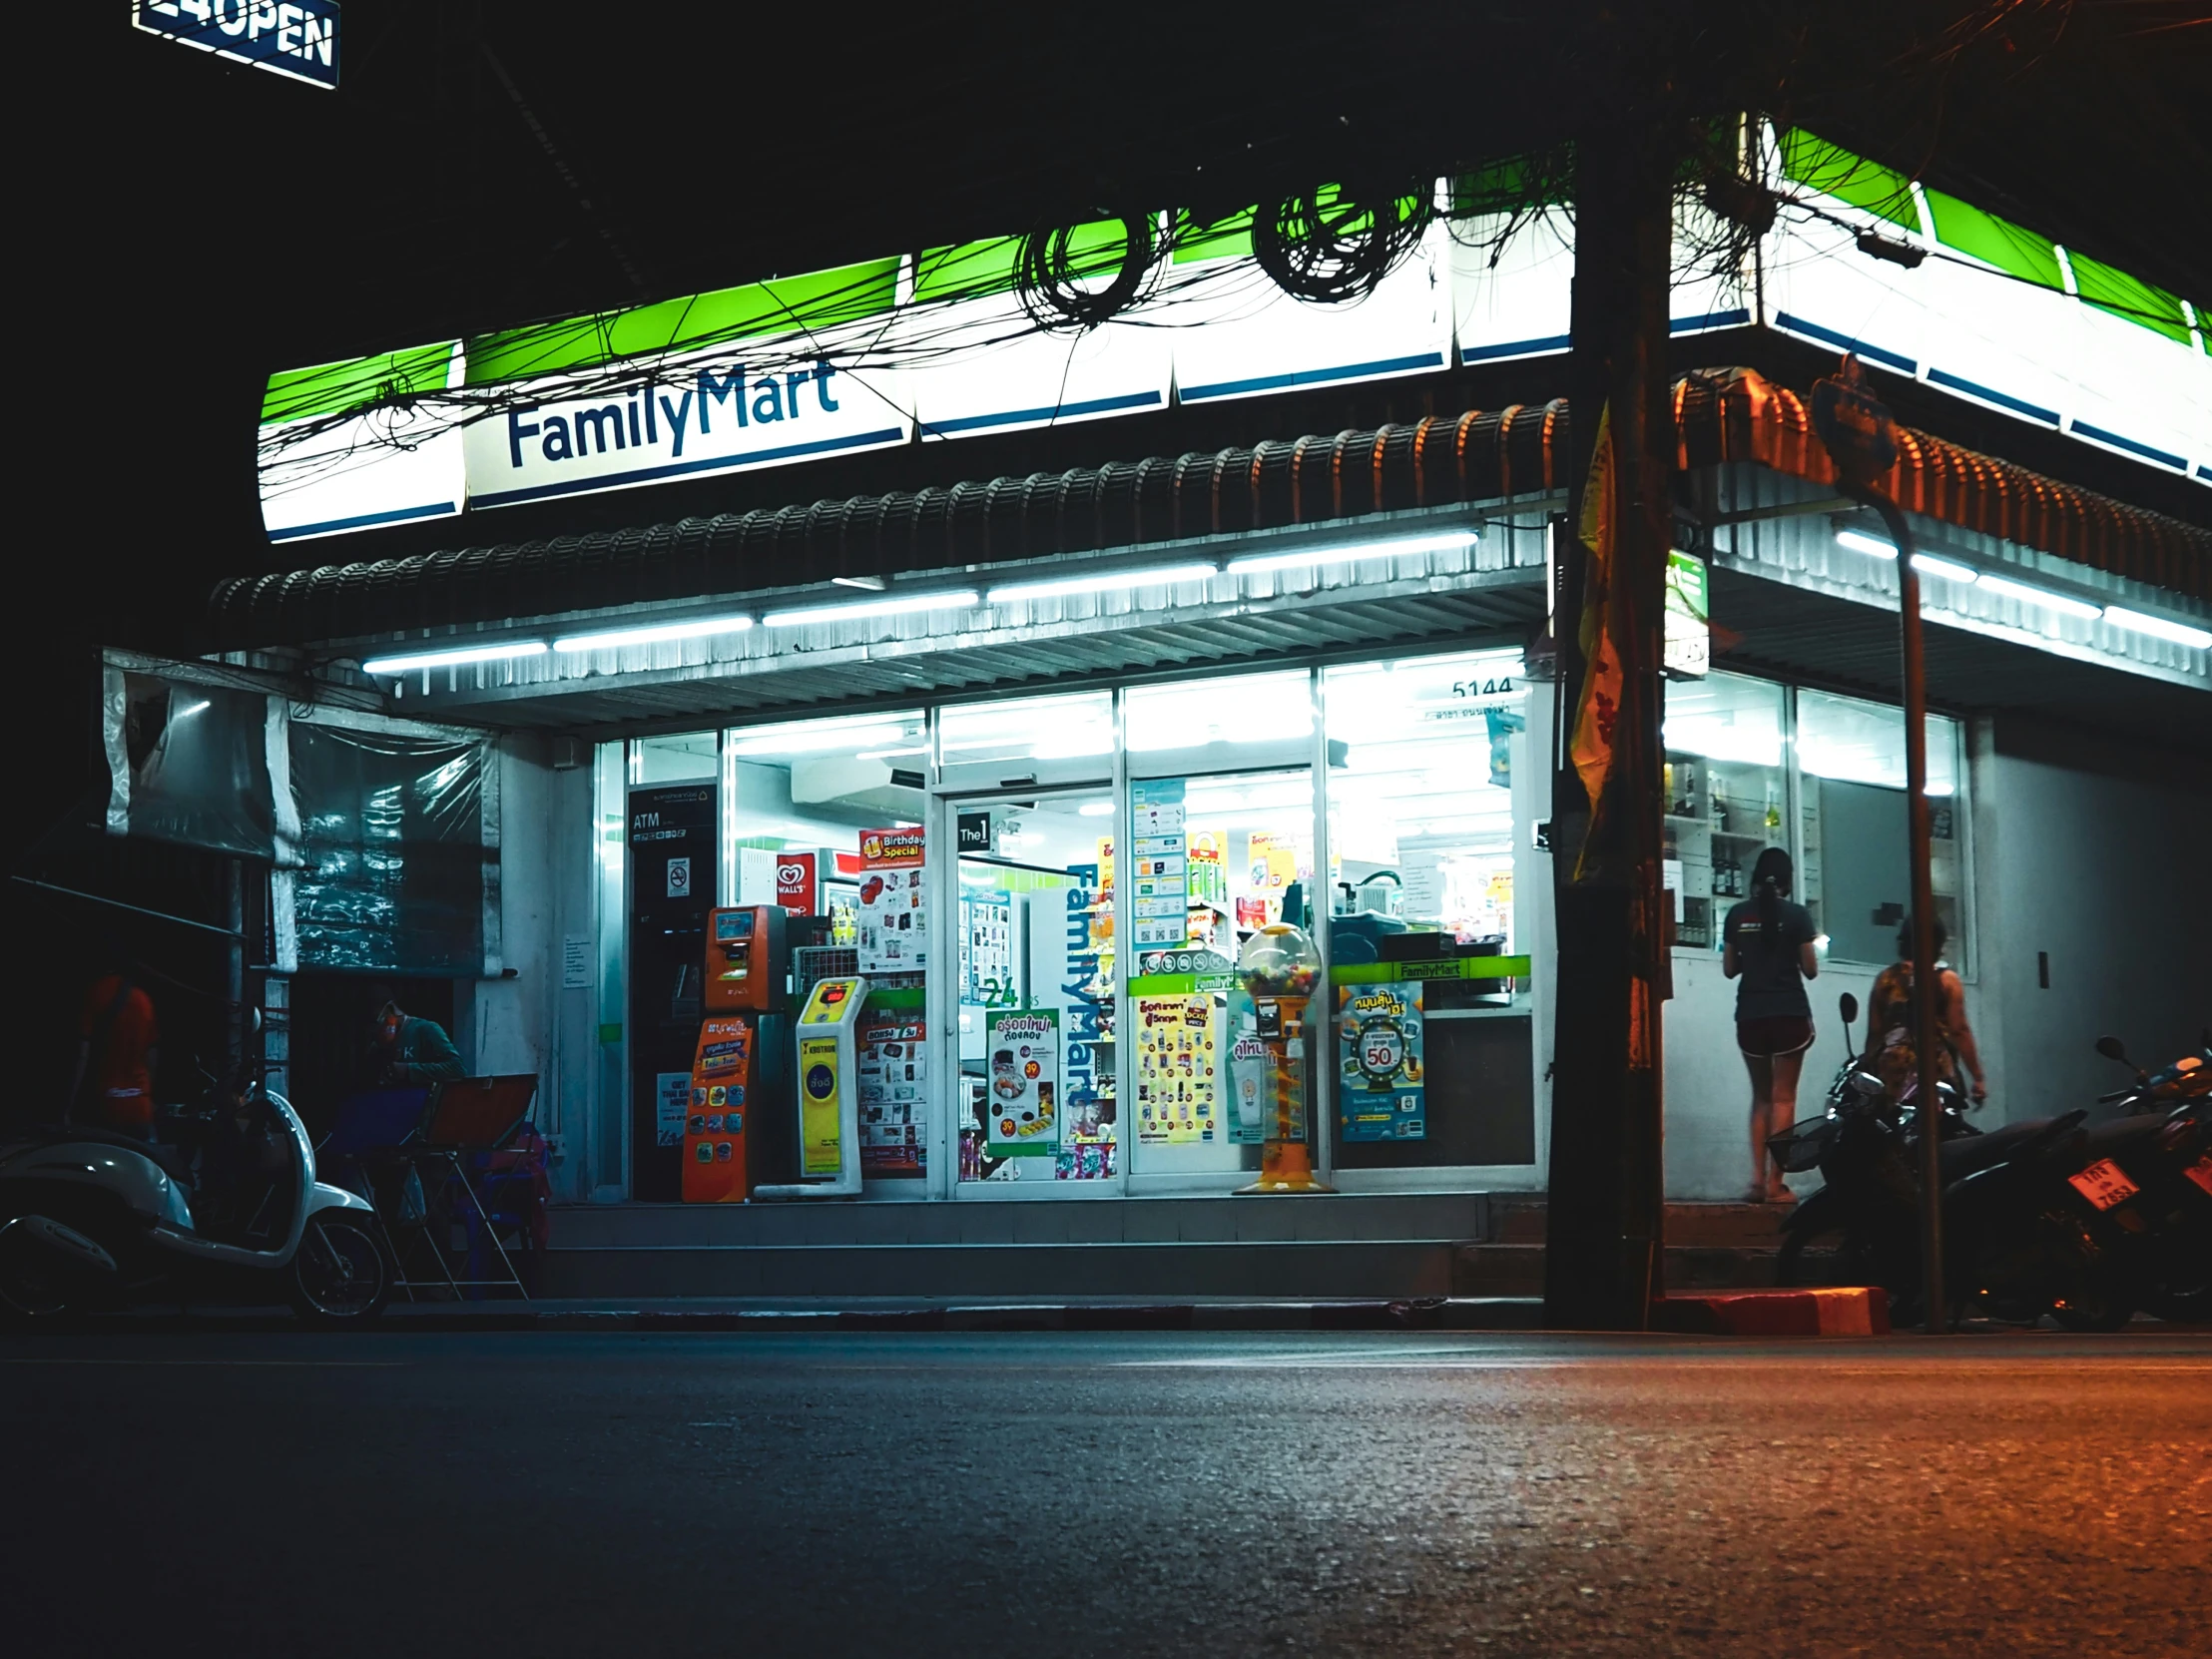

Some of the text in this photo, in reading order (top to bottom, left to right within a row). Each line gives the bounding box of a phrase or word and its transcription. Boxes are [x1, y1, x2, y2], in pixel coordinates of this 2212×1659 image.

[509, 360, 839, 468] FamilyMart
[1452, 677, 1513, 698] 5144
[634, 813, 660, 830] ATM
[960, 820, 988, 843] The 1
[883, 834, 925, 846] Birthday
[883, 845, 918, 858] Special
[778, 885, 804, 894] WALL'S
[1400, 963, 1460, 978] FamilyMart
[984, 977, 1018, 1008] 24
[1061, 863, 1100, 1107] FamilyMart
[1026, 1063, 1037, 1073] 39
[1002, 1120, 1013, 1131] 39
